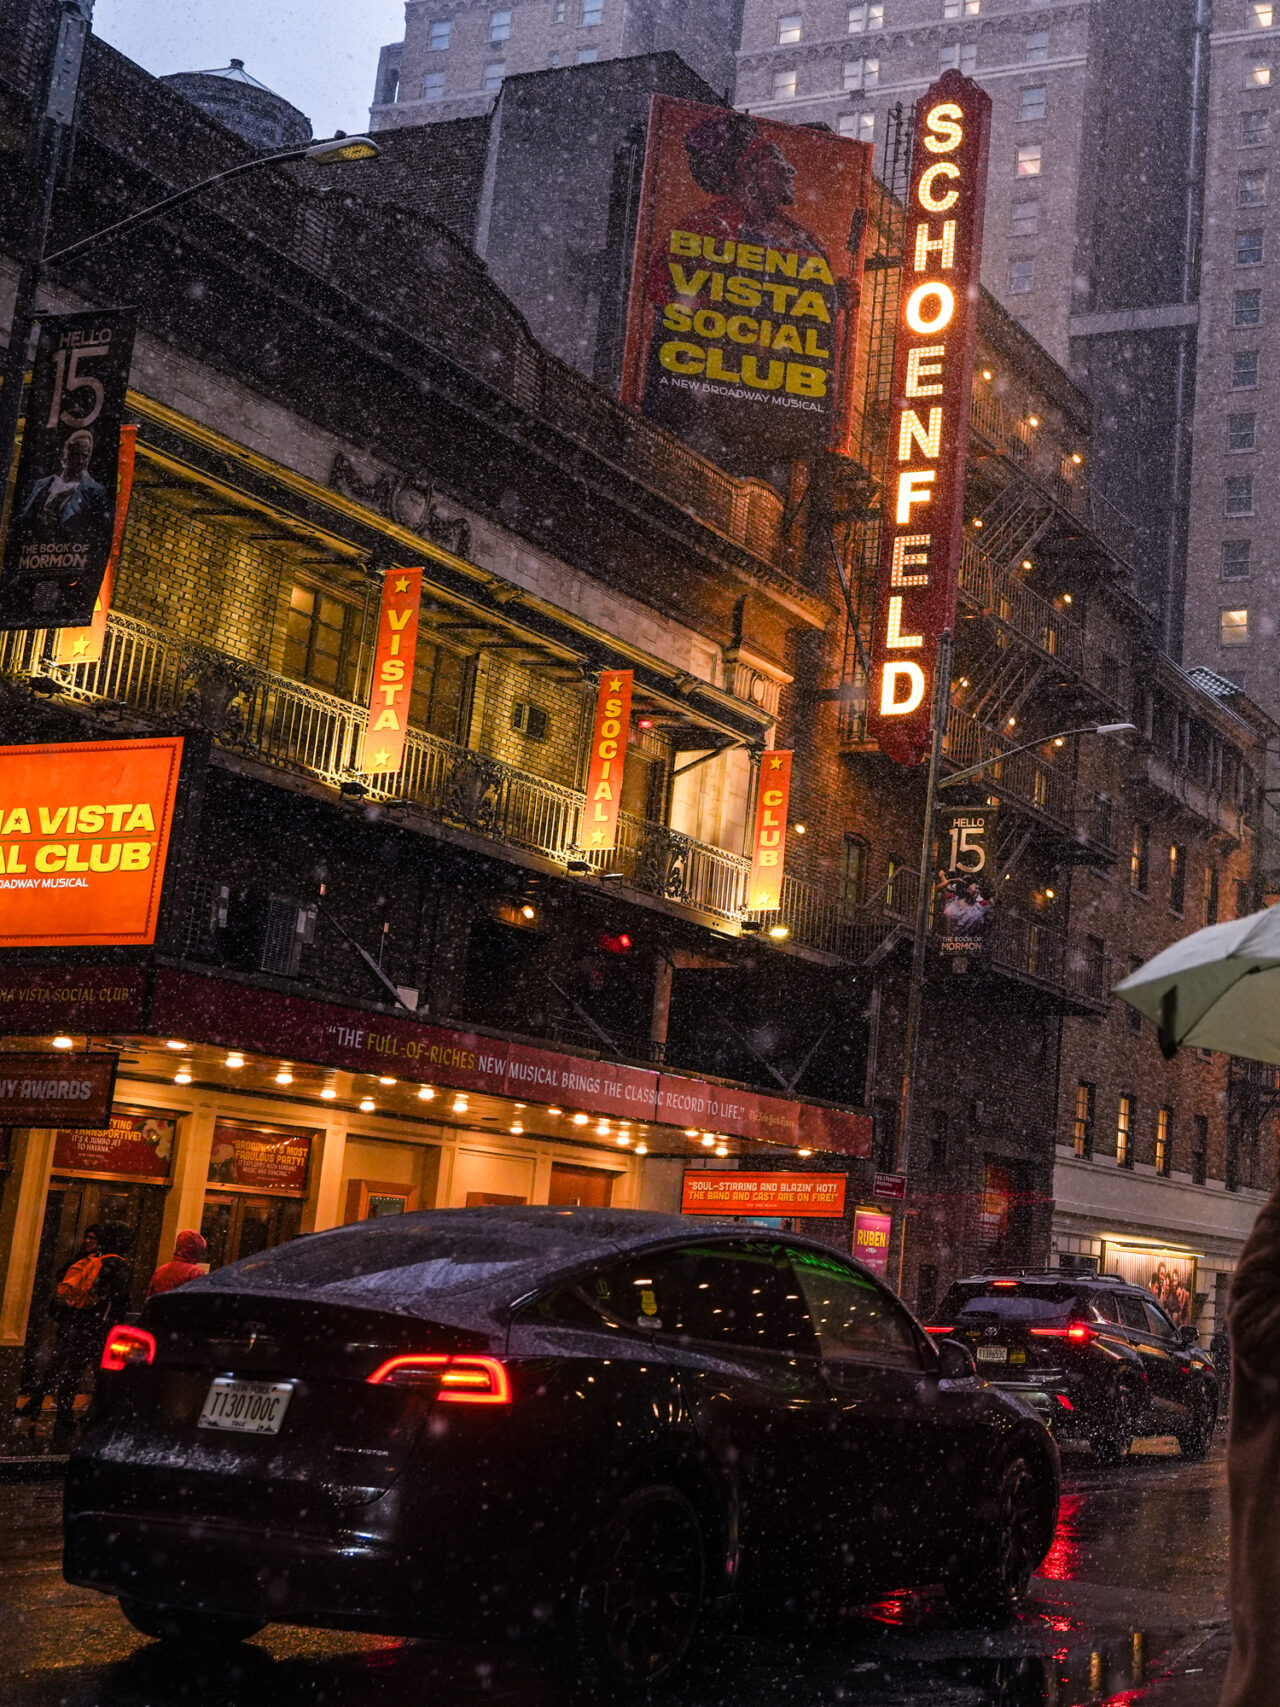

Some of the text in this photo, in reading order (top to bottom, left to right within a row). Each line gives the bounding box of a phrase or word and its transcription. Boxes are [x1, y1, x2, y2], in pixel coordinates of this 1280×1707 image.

[669, 230, 834, 286] BUENA
[668, 262, 832, 324] VISTA
[59, 328, 112, 348] HELLO
[662, 303, 830, 358] SOCIAL
[659, 341, 828, 398] CLUB
[46, 345, 110, 429] 15
[659, 376, 825, 413] A NEW BROADWAY MUSICAL
[879, 102, 964, 716] SCHOENFELD
[18, 553, 88, 569] MORMON
[21, 543, 90, 554] THE BOOK OF
[374, 609, 413, 732] VISTA
[594, 699, 623, 822] SOCIAL
[38, 804, 156, 835] VISTA
[760, 790, 783, 867] CLUB
[953, 818, 985, 828] HELLO
[35, 842, 152, 873] CLUB
[949, 828, 986, 873] 15
[41, 878, 89, 889] MUSICAL
[941, 942, 982, 951] MORMON
[19, 988, 51, 1001] VISTA
[54, 987, 95, 1001] SOCIAL
[366, 1033, 475, 1070] FULL-OF-RICHES
[478, 1054, 507, 1077] NEW
[508, 1062, 558, 1087] MUSICAL
[561, 1071, 601, 1094] BRINGS
[603, 1080, 622, 1098] THE
[625, 1085, 664, 1107] CLASSIC
[666, 1091, 706, 1114] RECORD
[707, 1100, 719, 1116] TO
[20, 1080, 92, 1101] AWARDS
[77, 1143, 86, 1151] TO
[235, 1150, 275, 1163] FABULOUS
[286, 1146, 309, 1157] MOST
[688, 1191, 705, 1200] THE
[708, 1191, 730, 1201] BAND
[733, 1192, 750, 1201] AND
[752, 1192, 775, 1201] CAST
[777, 1192, 795, 1202] ARE
[798, 1192, 810, 1202] ON
[760, 1183, 777, 1192] AND
[816, 1183, 837, 1193] HOT!
[857, 1226, 887, 1248] RUBÉN
[210, 1392, 280, 1422] T130100C
